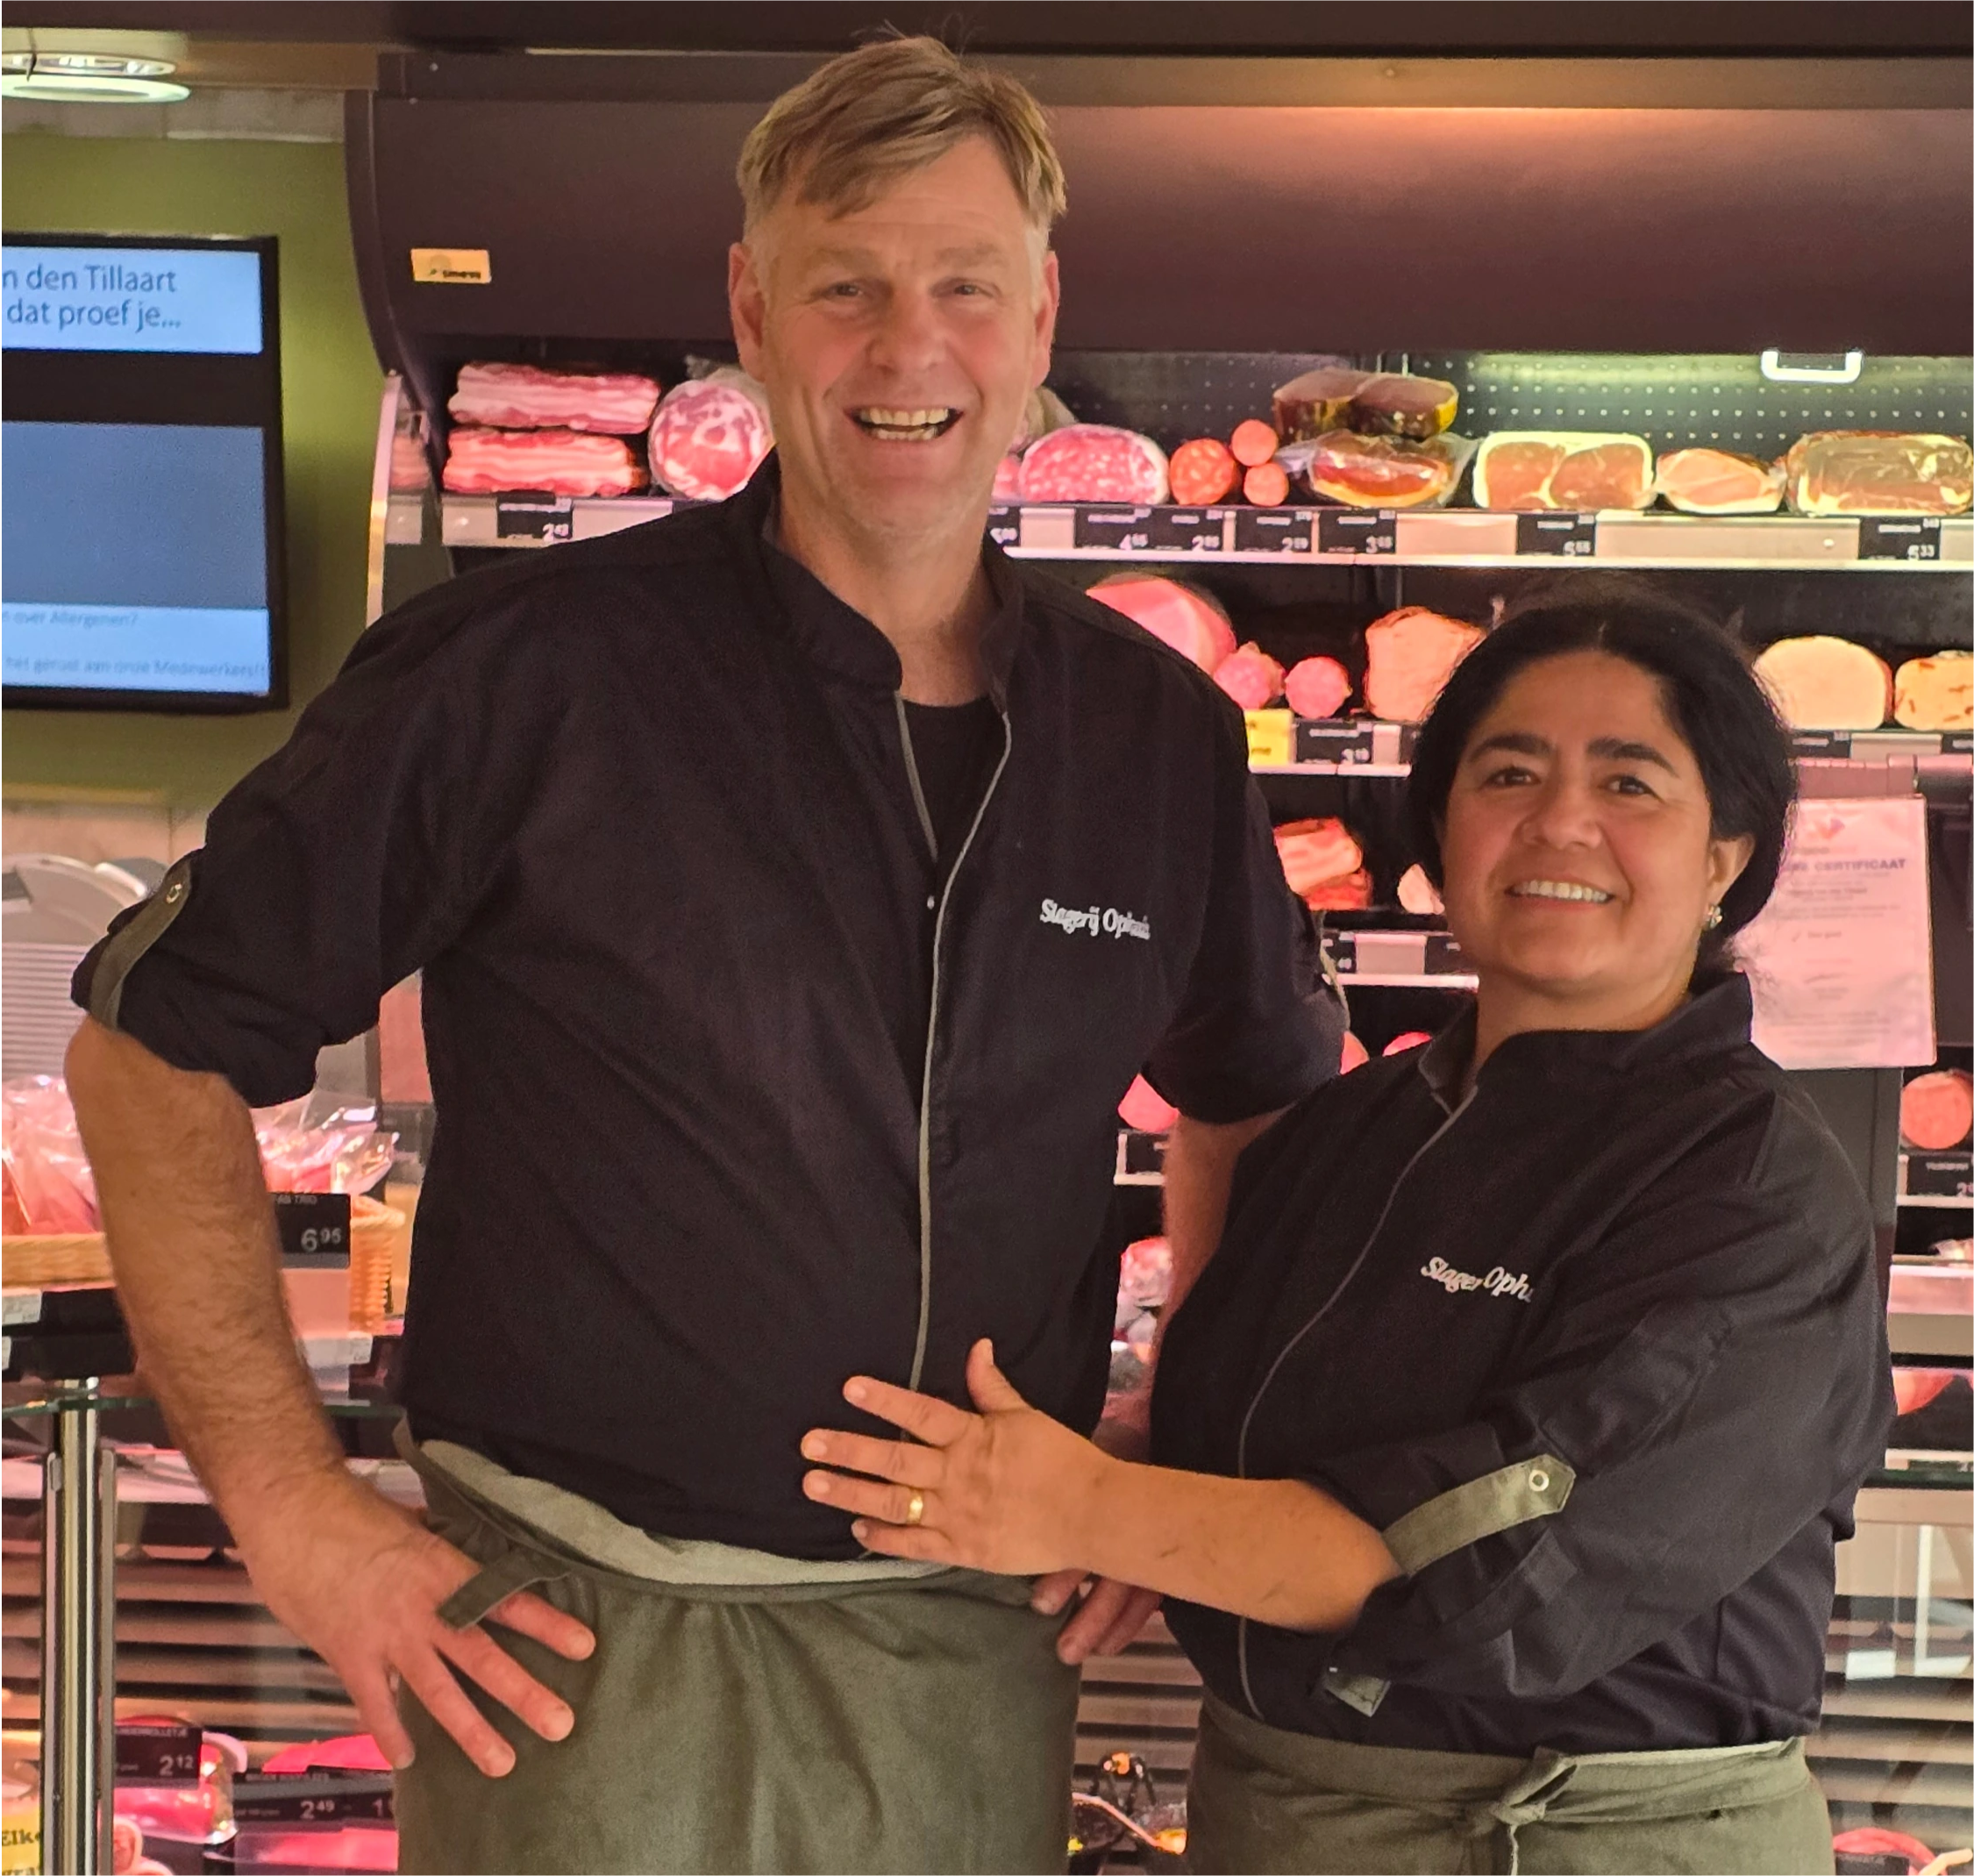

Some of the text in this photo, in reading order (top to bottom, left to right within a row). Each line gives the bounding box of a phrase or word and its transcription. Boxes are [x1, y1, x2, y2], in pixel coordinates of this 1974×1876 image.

[25, 264, 77, 290] den
[85, 265, 177, 292] Tillaart
[7, 298, 50, 325] dat
[58, 299, 131, 331] proef
[1814, 859, 1906, 872] CERTIFICAAT
